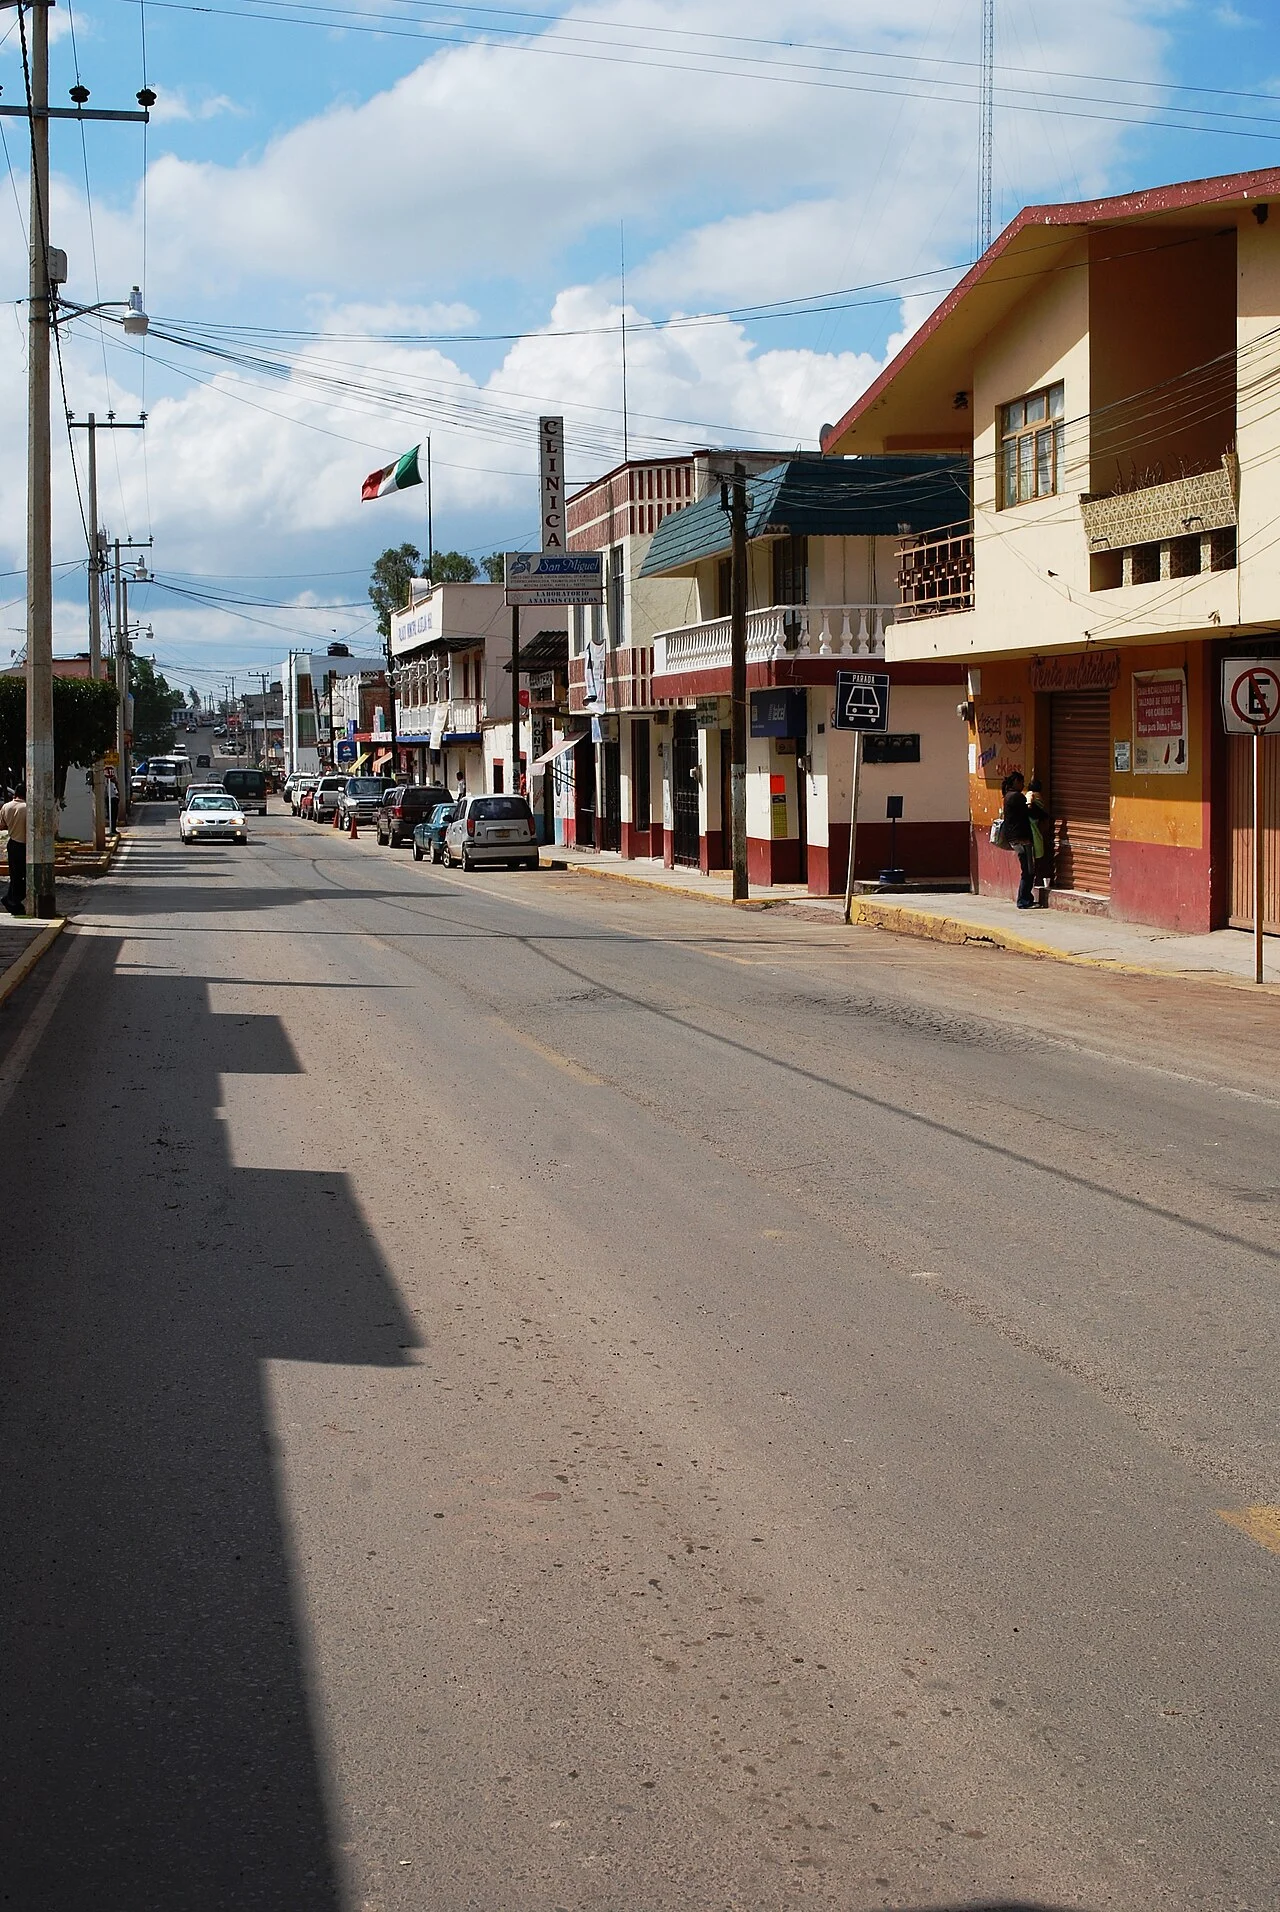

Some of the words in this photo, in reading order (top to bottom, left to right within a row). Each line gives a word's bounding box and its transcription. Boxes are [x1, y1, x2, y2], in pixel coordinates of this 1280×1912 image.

[543, 420, 561, 547] CLINICA
[540, 559, 560, 572] San
[562, 558, 598, 573] Miguel
[852, 674, 875, 684] PARADA
[1249, 678, 1271, 714] E
